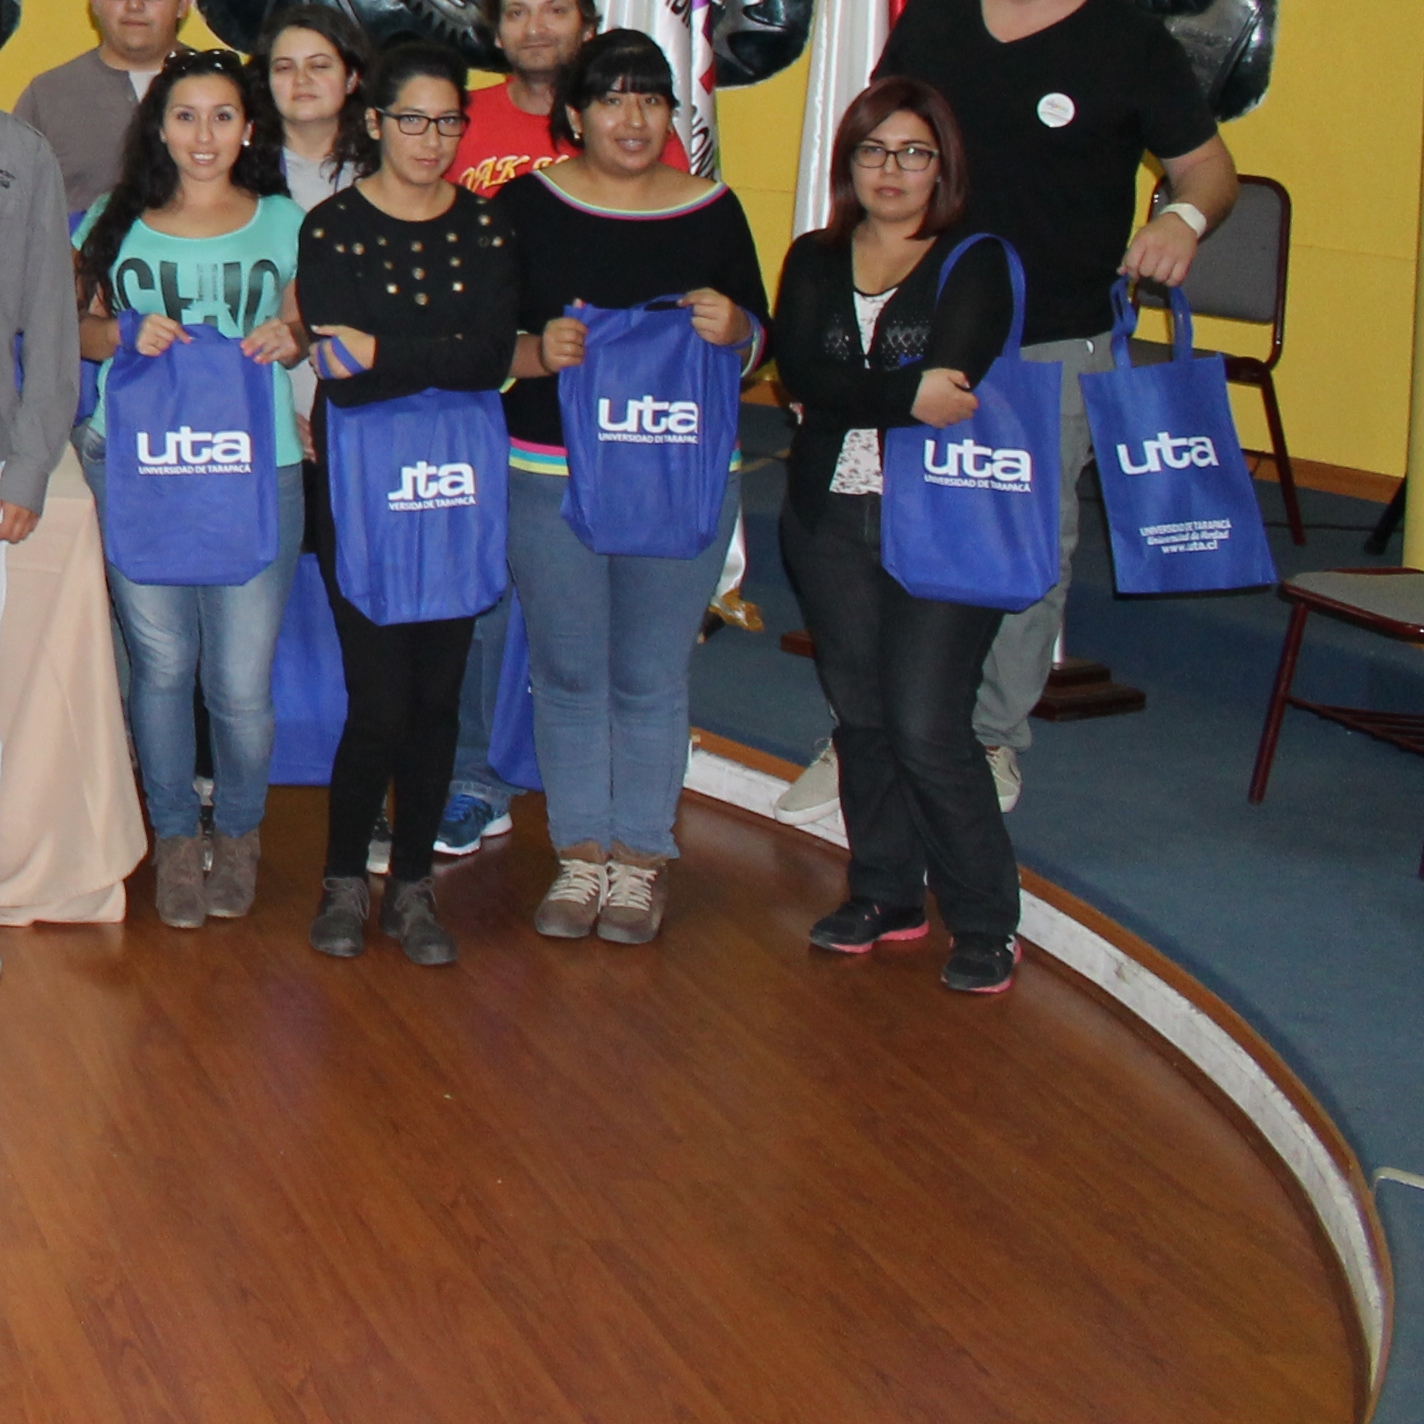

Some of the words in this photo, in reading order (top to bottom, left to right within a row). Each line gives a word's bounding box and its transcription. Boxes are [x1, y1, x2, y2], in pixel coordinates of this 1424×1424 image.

[597, 394, 700, 435] uta
[136, 425, 252, 466] uta
[925, 438, 1033, 484] uta
[1115, 430, 1221, 476] uta
[137, 465, 194, 476] UNIVERSIDAD
[194, 465, 208, 475] DE
[977, 478, 991, 490] DE
